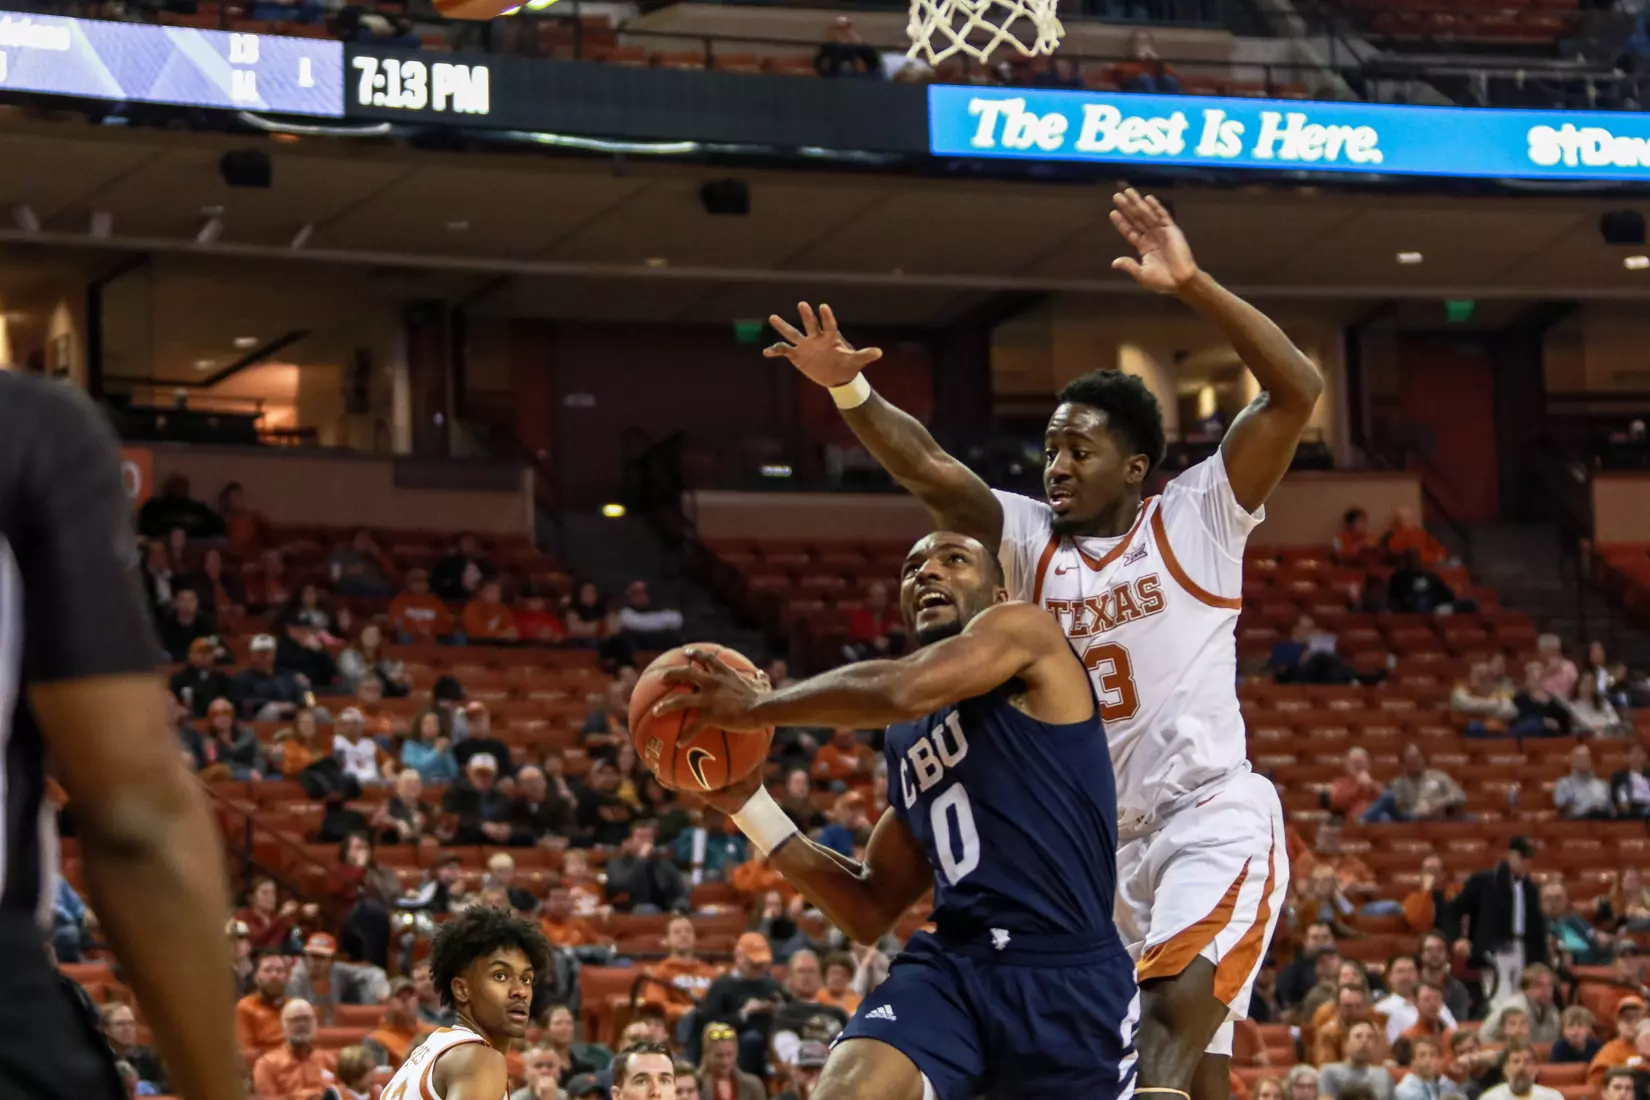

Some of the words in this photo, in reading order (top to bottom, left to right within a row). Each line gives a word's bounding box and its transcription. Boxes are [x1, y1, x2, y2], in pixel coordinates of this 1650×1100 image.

[352, 56, 428, 110] 7:13
[432, 63, 490, 115] PM
[968, 97, 1069, 151] The
[1074, 103, 1190, 156] Best
[1195, 108, 1246, 159] Is
[1251, 111, 1384, 164] Here.
[1045, 572, 1168, 640] TEXAS
[1082, 641, 1141, 724] 3
[900, 709, 969, 811] CBU
[930, 781, 981, 887] 0
